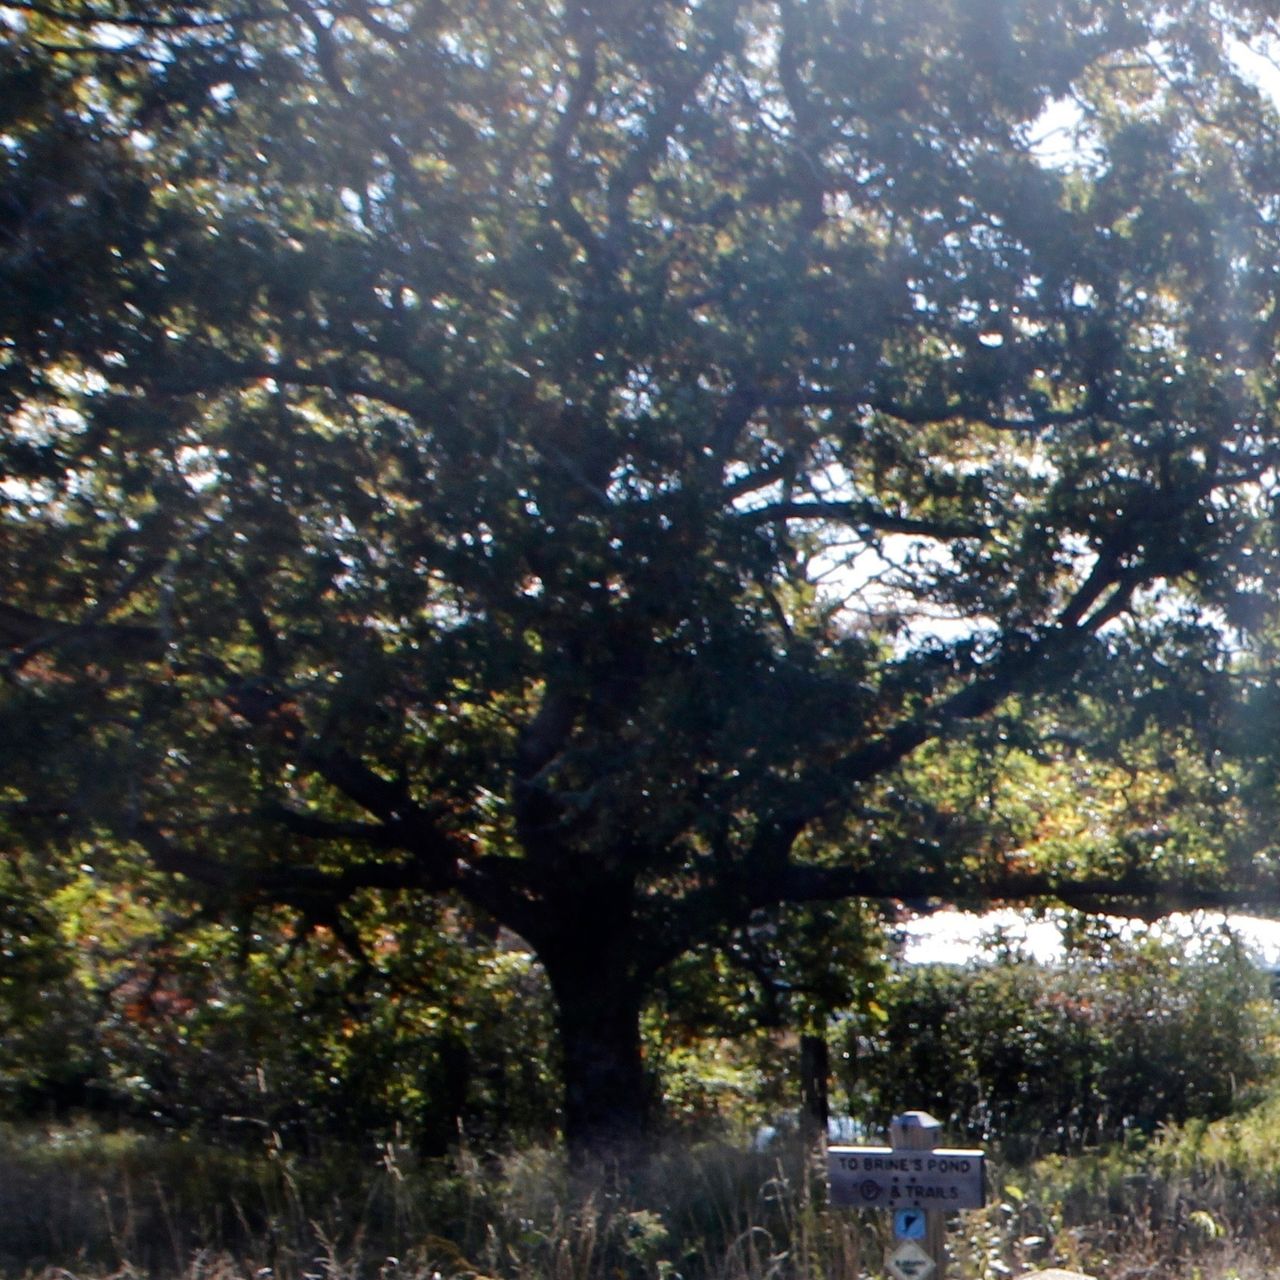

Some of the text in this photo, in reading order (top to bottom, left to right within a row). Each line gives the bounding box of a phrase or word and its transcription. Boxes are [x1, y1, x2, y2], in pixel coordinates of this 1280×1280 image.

[839, 1158, 971, 1173] TO BRINE'S POND
[905, 1186, 959, 1199] TRAILS
